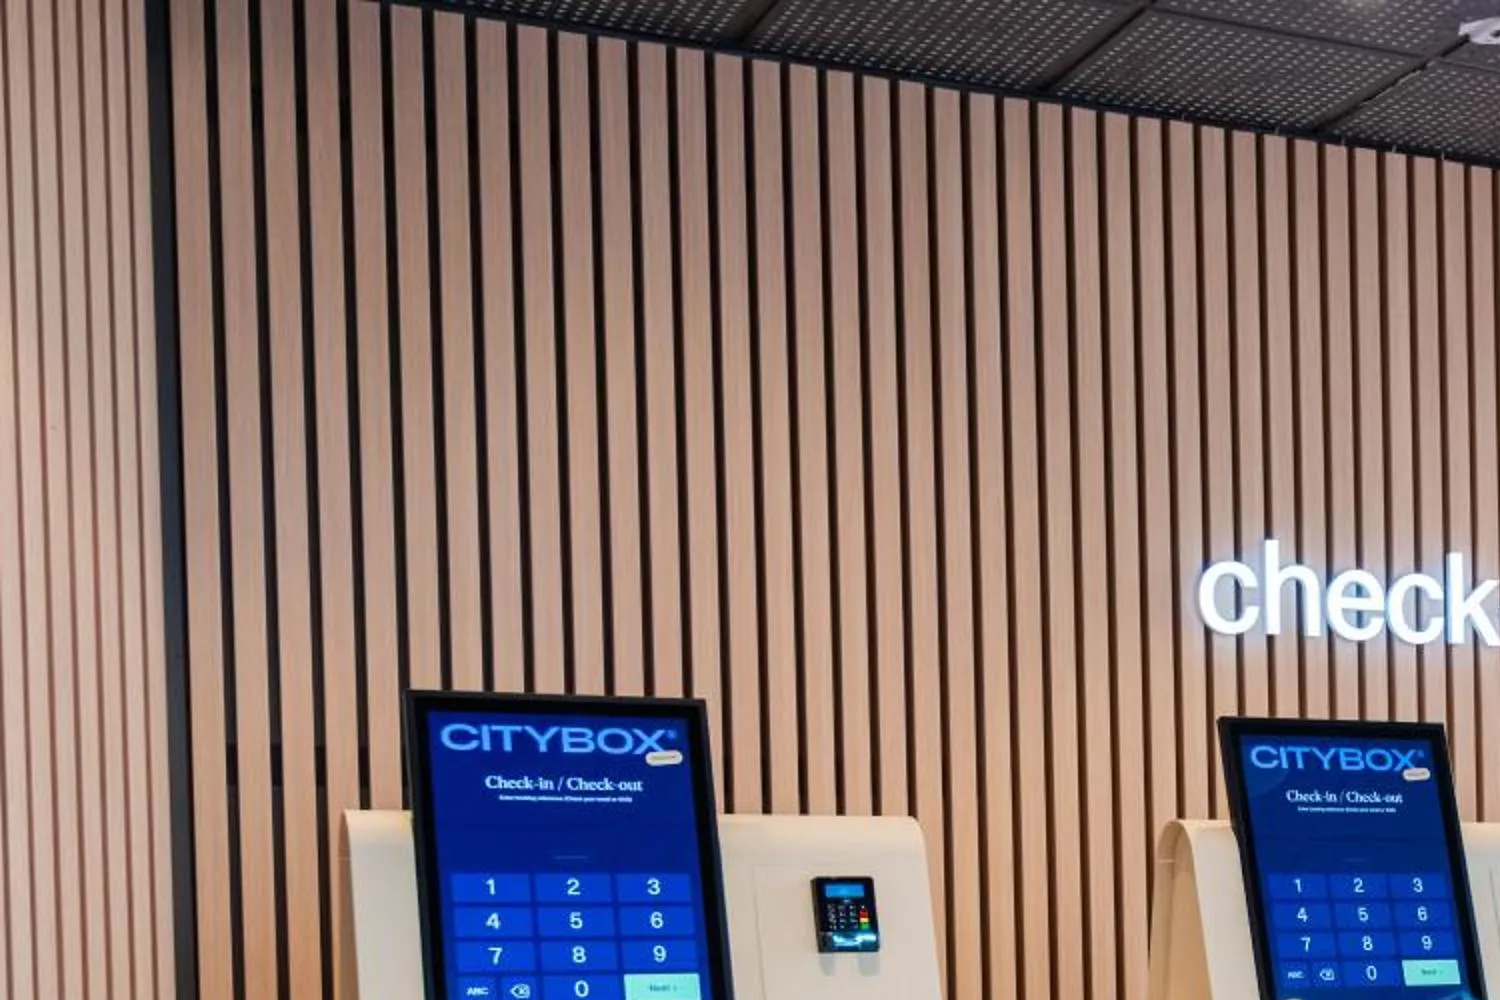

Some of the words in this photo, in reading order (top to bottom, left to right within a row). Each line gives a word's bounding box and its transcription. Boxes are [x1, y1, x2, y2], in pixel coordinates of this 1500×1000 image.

[484, 775, 555, 791] Check-in
[566, 776, 643, 793] Check-out
[1285, 789, 1338, 803] Check-in
[1345, 789, 1403, 804] Check-out
[486, 878, 496, 895] 1
[566, 878, 581, 896] 2
[647, 878, 661, 895] 3
[1294, 878, 1302, 893] 1
[1353, 877, 1365, 893] 2
[1412, 877, 1424, 893] 3
[485, 912, 501, 929] 4
[569, 911, 583, 929] 5
[650, 911, 664, 929] 6
[1297, 907, 1308, 923] 4
[1357, 907, 1369, 922] 5
[1417, 906, 1428, 921] 6
[1301, 936, 1311, 952] 7
[1362, 935, 1373, 951] 8
[1421, 935, 1433, 951] 9
[488, 947, 503, 965] 7
[572, 945, 587, 964] 8
[652, 945, 667, 963] 9
[1365, 965, 1377, 981] 0
[574, 979, 589, 998] 0
